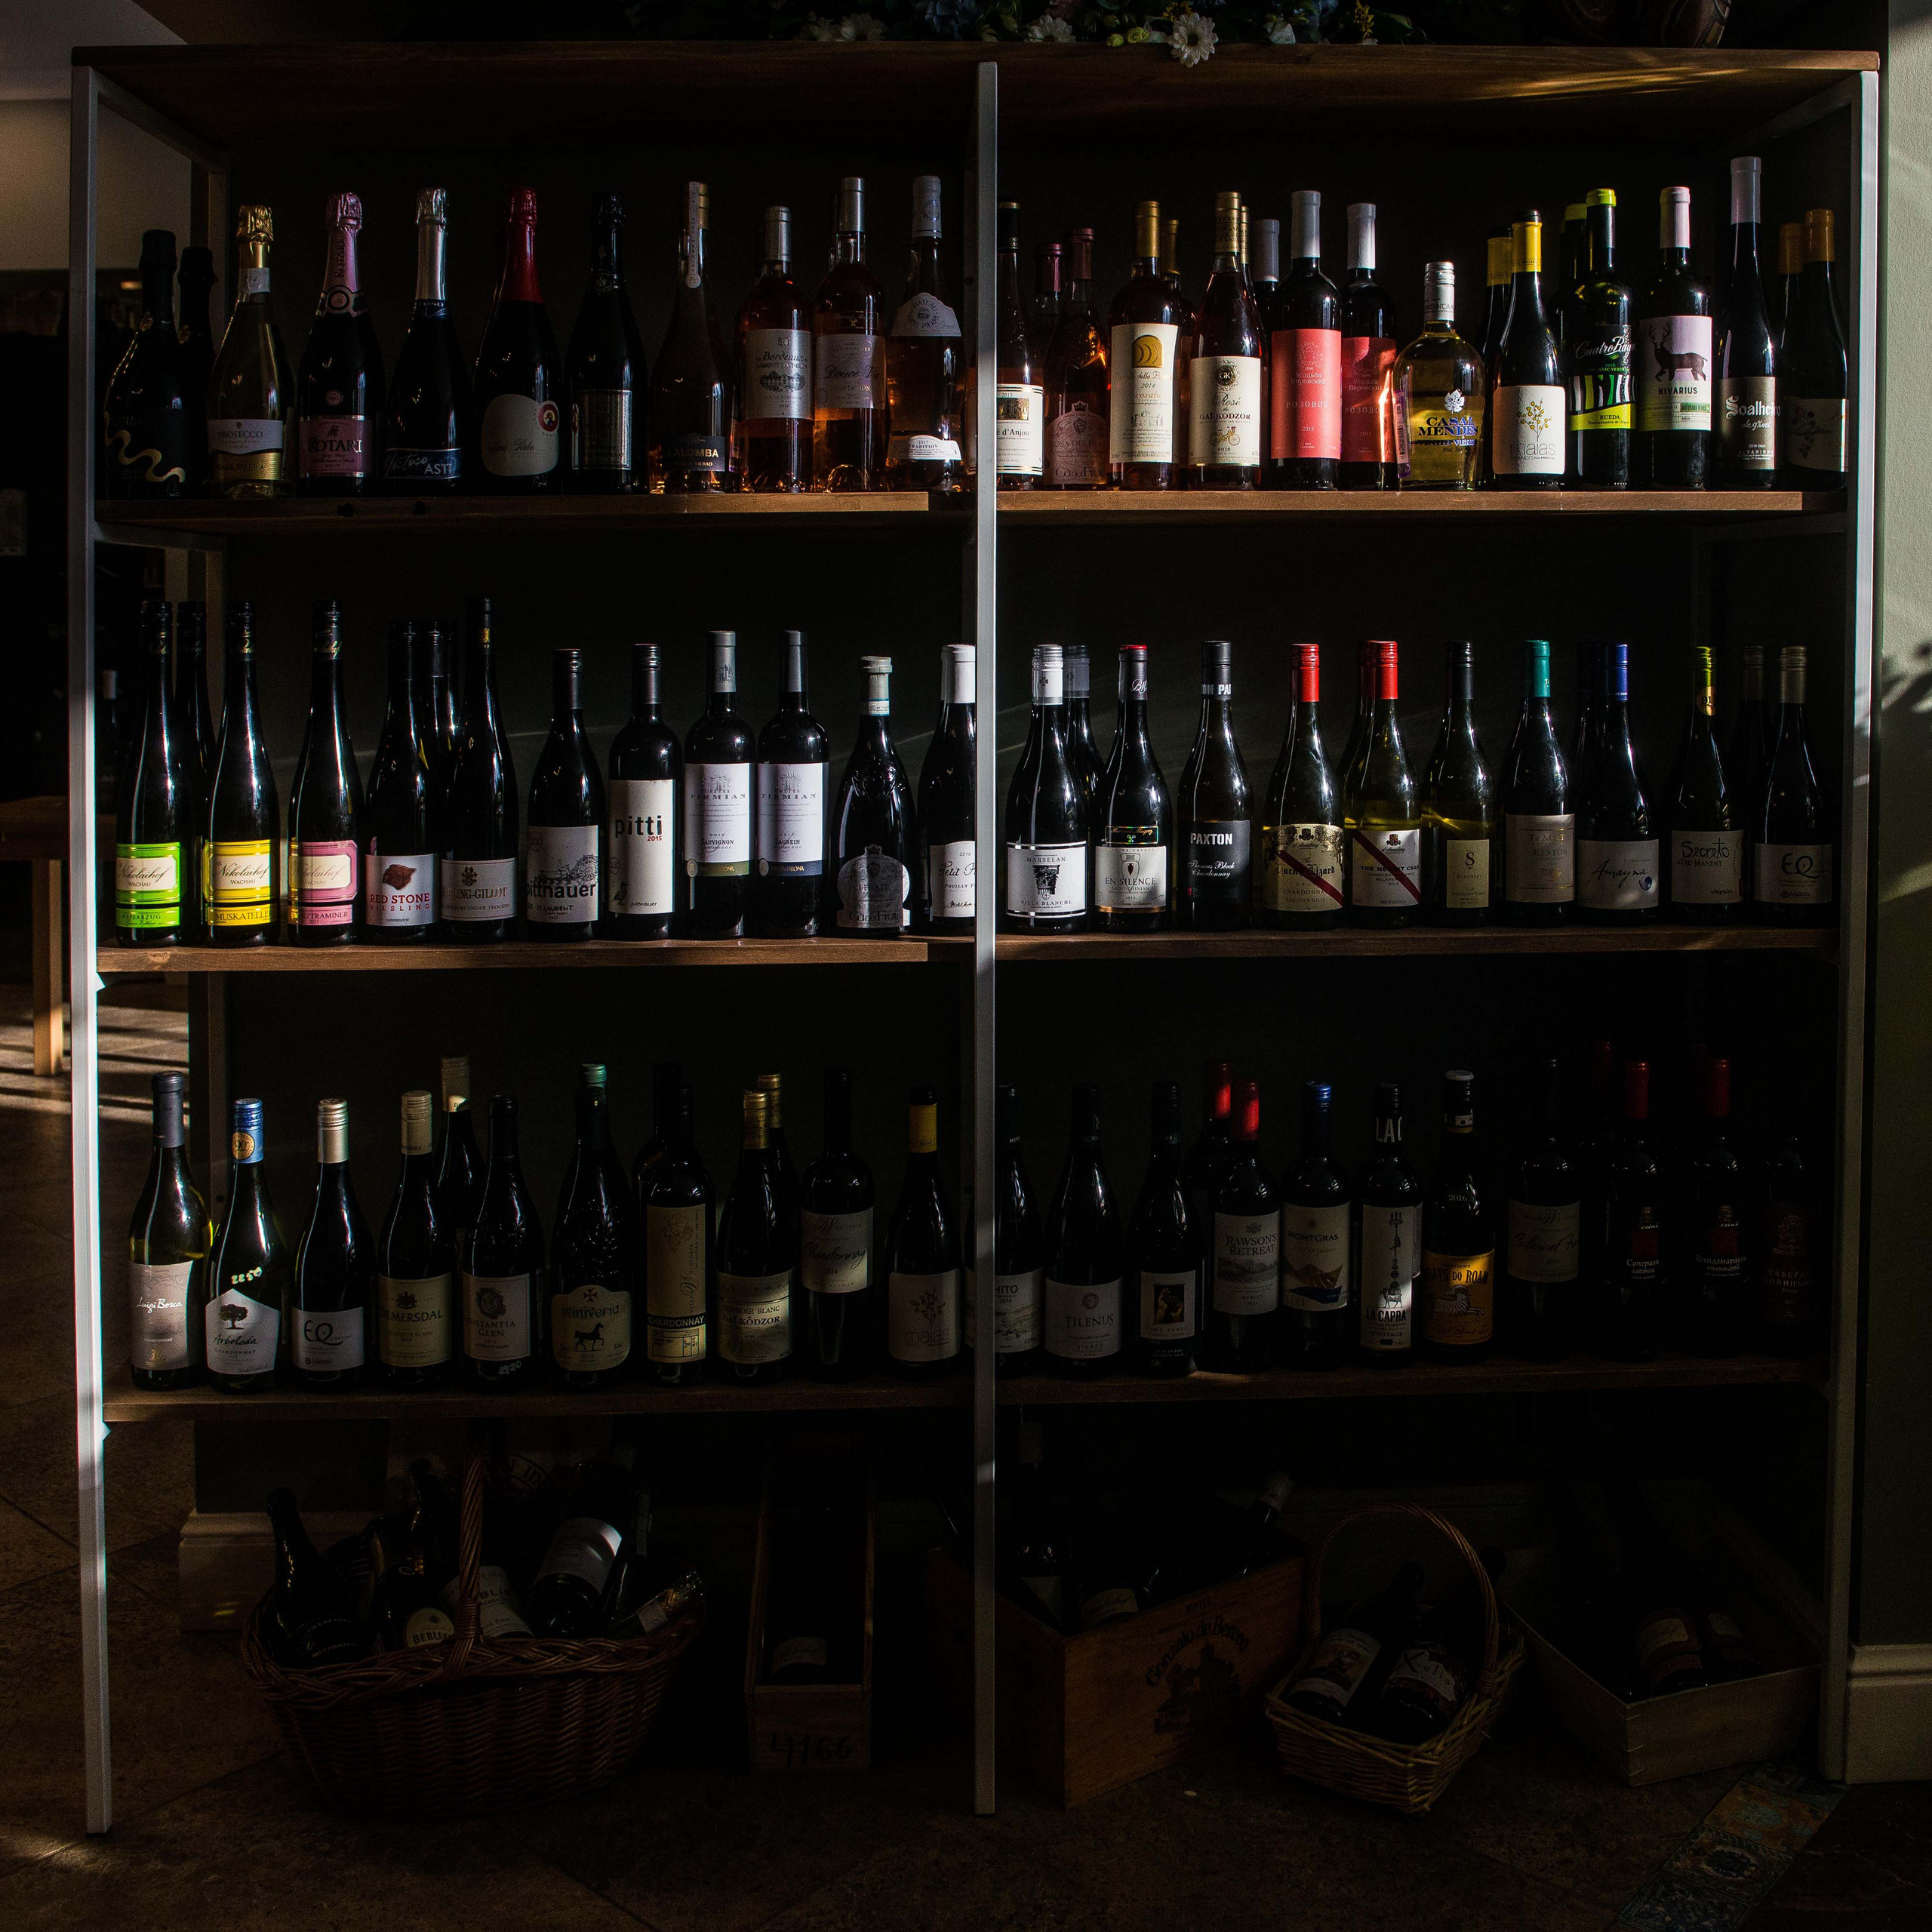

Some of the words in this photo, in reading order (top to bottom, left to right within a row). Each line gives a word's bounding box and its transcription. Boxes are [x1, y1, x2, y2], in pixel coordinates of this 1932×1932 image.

[763, 351, 804, 361] Bordeaux
[826, 365, 859, 380] Douce
[865, 365, 881, 380] Vie
[1658, 386, 1698, 395] NIVARIUS
[1211, 392, 1240, 406] Rosé
[1426, 416, 1475, 426] CASAL
[217, 430, 263, 439] PROSECCO
[1001, 428, 1030, 437] d'Anjou
[1418, 426, 1478, 436] MENDES
[308, 438, 362, 454] ROTARI
[1510, 442, 1555, 455] maias
[424, 463, 452, 475] ASTI
[615, 815, 663, 838] pitti
[1190, 832, 1232, 845] PAXTON
[1681, 837, 1730, 859] Secreto
[1187, 860, 1213, 869] Thomas
[1214, 860, 1235, 869] Block
[1465, 851, 1475, 866] S
[213, 863, 270, 879] Nikolaihof
[938, 860, 960, 876] Petit
[1781, 852, 1820, 879] EQ
[117, 866, 168, 883] Nikolaihof
[1192, 869, 1231, 879] Chardonnay
[1119, 877, 1156, 885] SILENCE
[371, 894, 388, 904] RED
[391, 893, 430, 904] STONE
[371, 903, 430, 912] RIESLING
[835, 1222, 862, 1231] VICTORIA
[803, 1241, 866, 1270] Chardonnay
[1229, 1244, 1275, 1256] RETREAT
[1452, 1271, 1463, 1281] DO
[1466, 1269, 1489, 1284] ROAM
[136, 1296, 156, 1314] Luigi
[157, 1298, 183, 1309] Bosca
[757, 1305, 780, 1315] BLANC
[648, 1315, 704, 1327] CHARDONNAY
[1064, 1313, 1114, 1328] TILENUS
[1366, 1308, 1376, 1321] LA
[1378, 1309, 1406, 1321] CAPRA
[304, 1320, 343, 1346] EQ
[478, 1328, 504, 1337] GLEN
[212, 1333, 259, 1346] Arboleda
